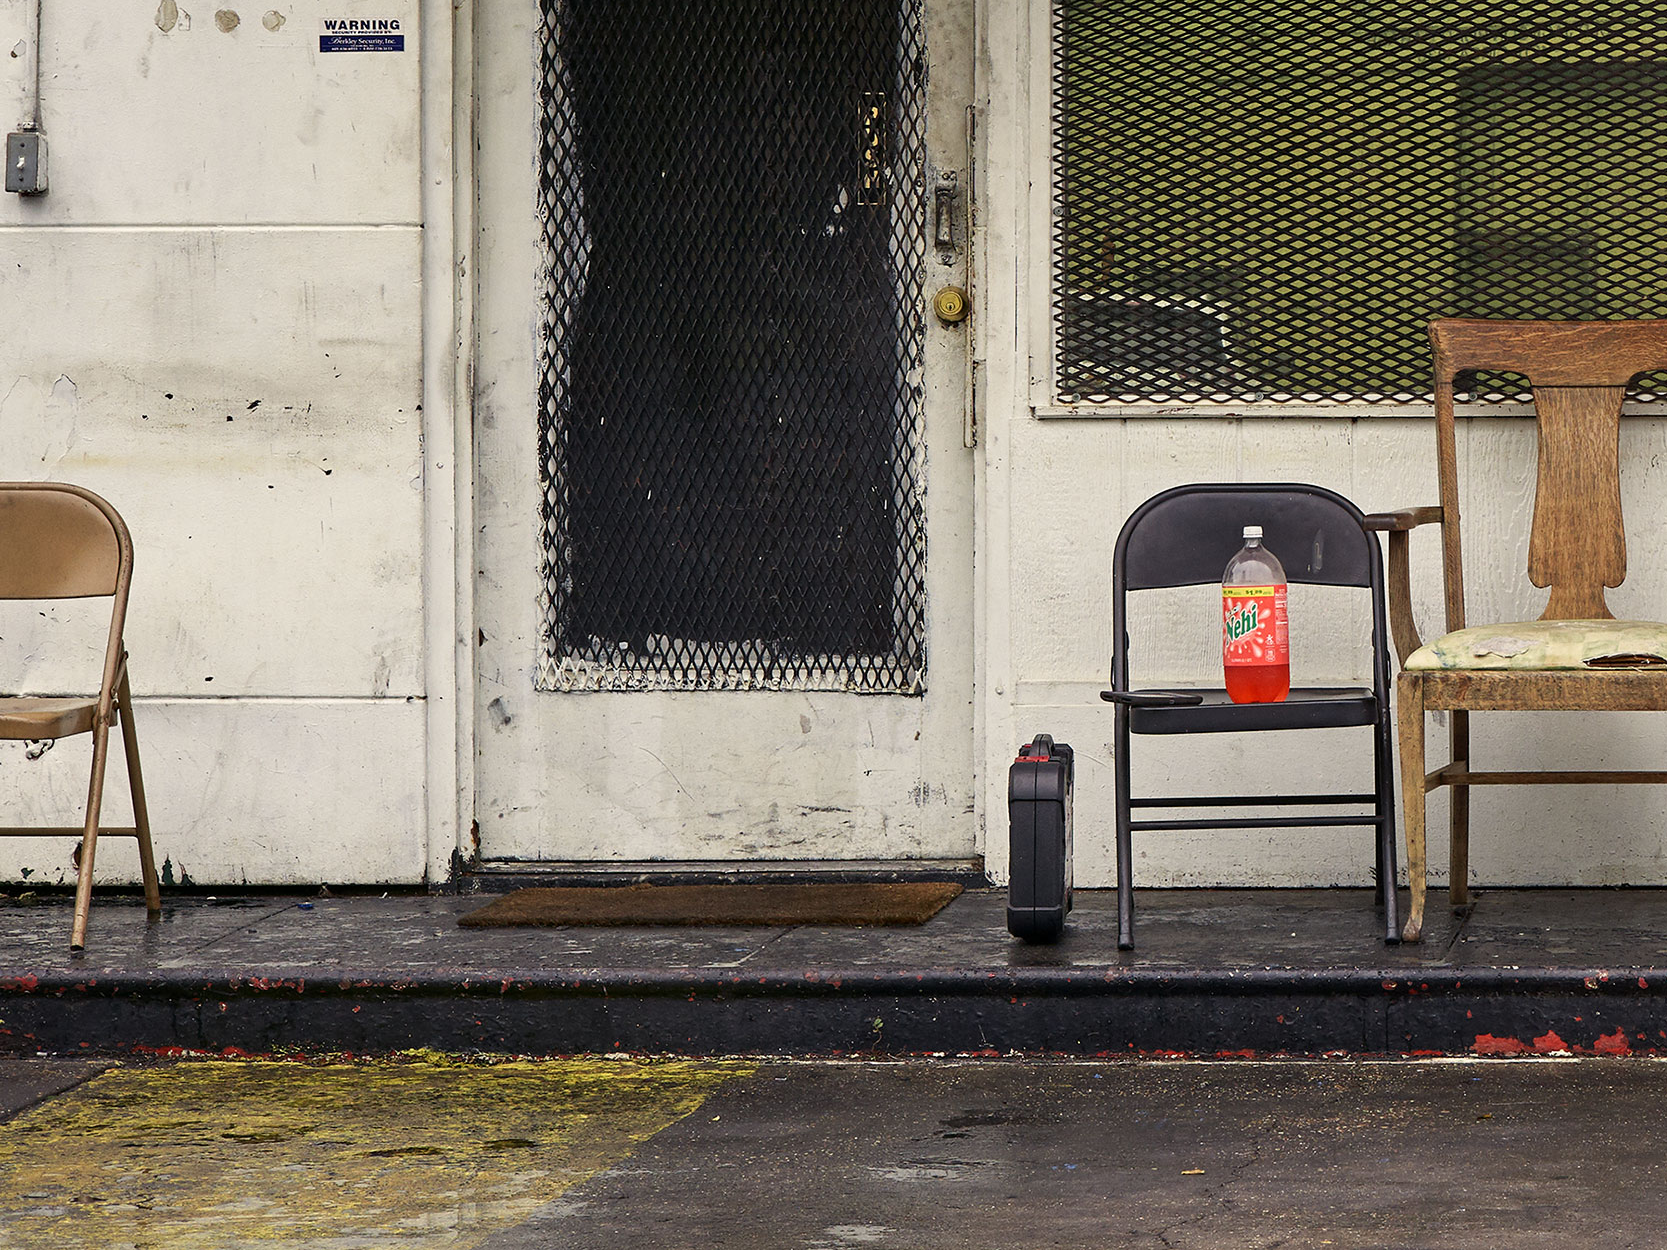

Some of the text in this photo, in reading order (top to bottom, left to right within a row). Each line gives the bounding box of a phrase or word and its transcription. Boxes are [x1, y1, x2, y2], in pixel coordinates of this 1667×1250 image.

[324, 20, 400, 30] WARNING
[358, 37, 384, 45] Security,
[1225, 603, 1258, 647] Nehi
